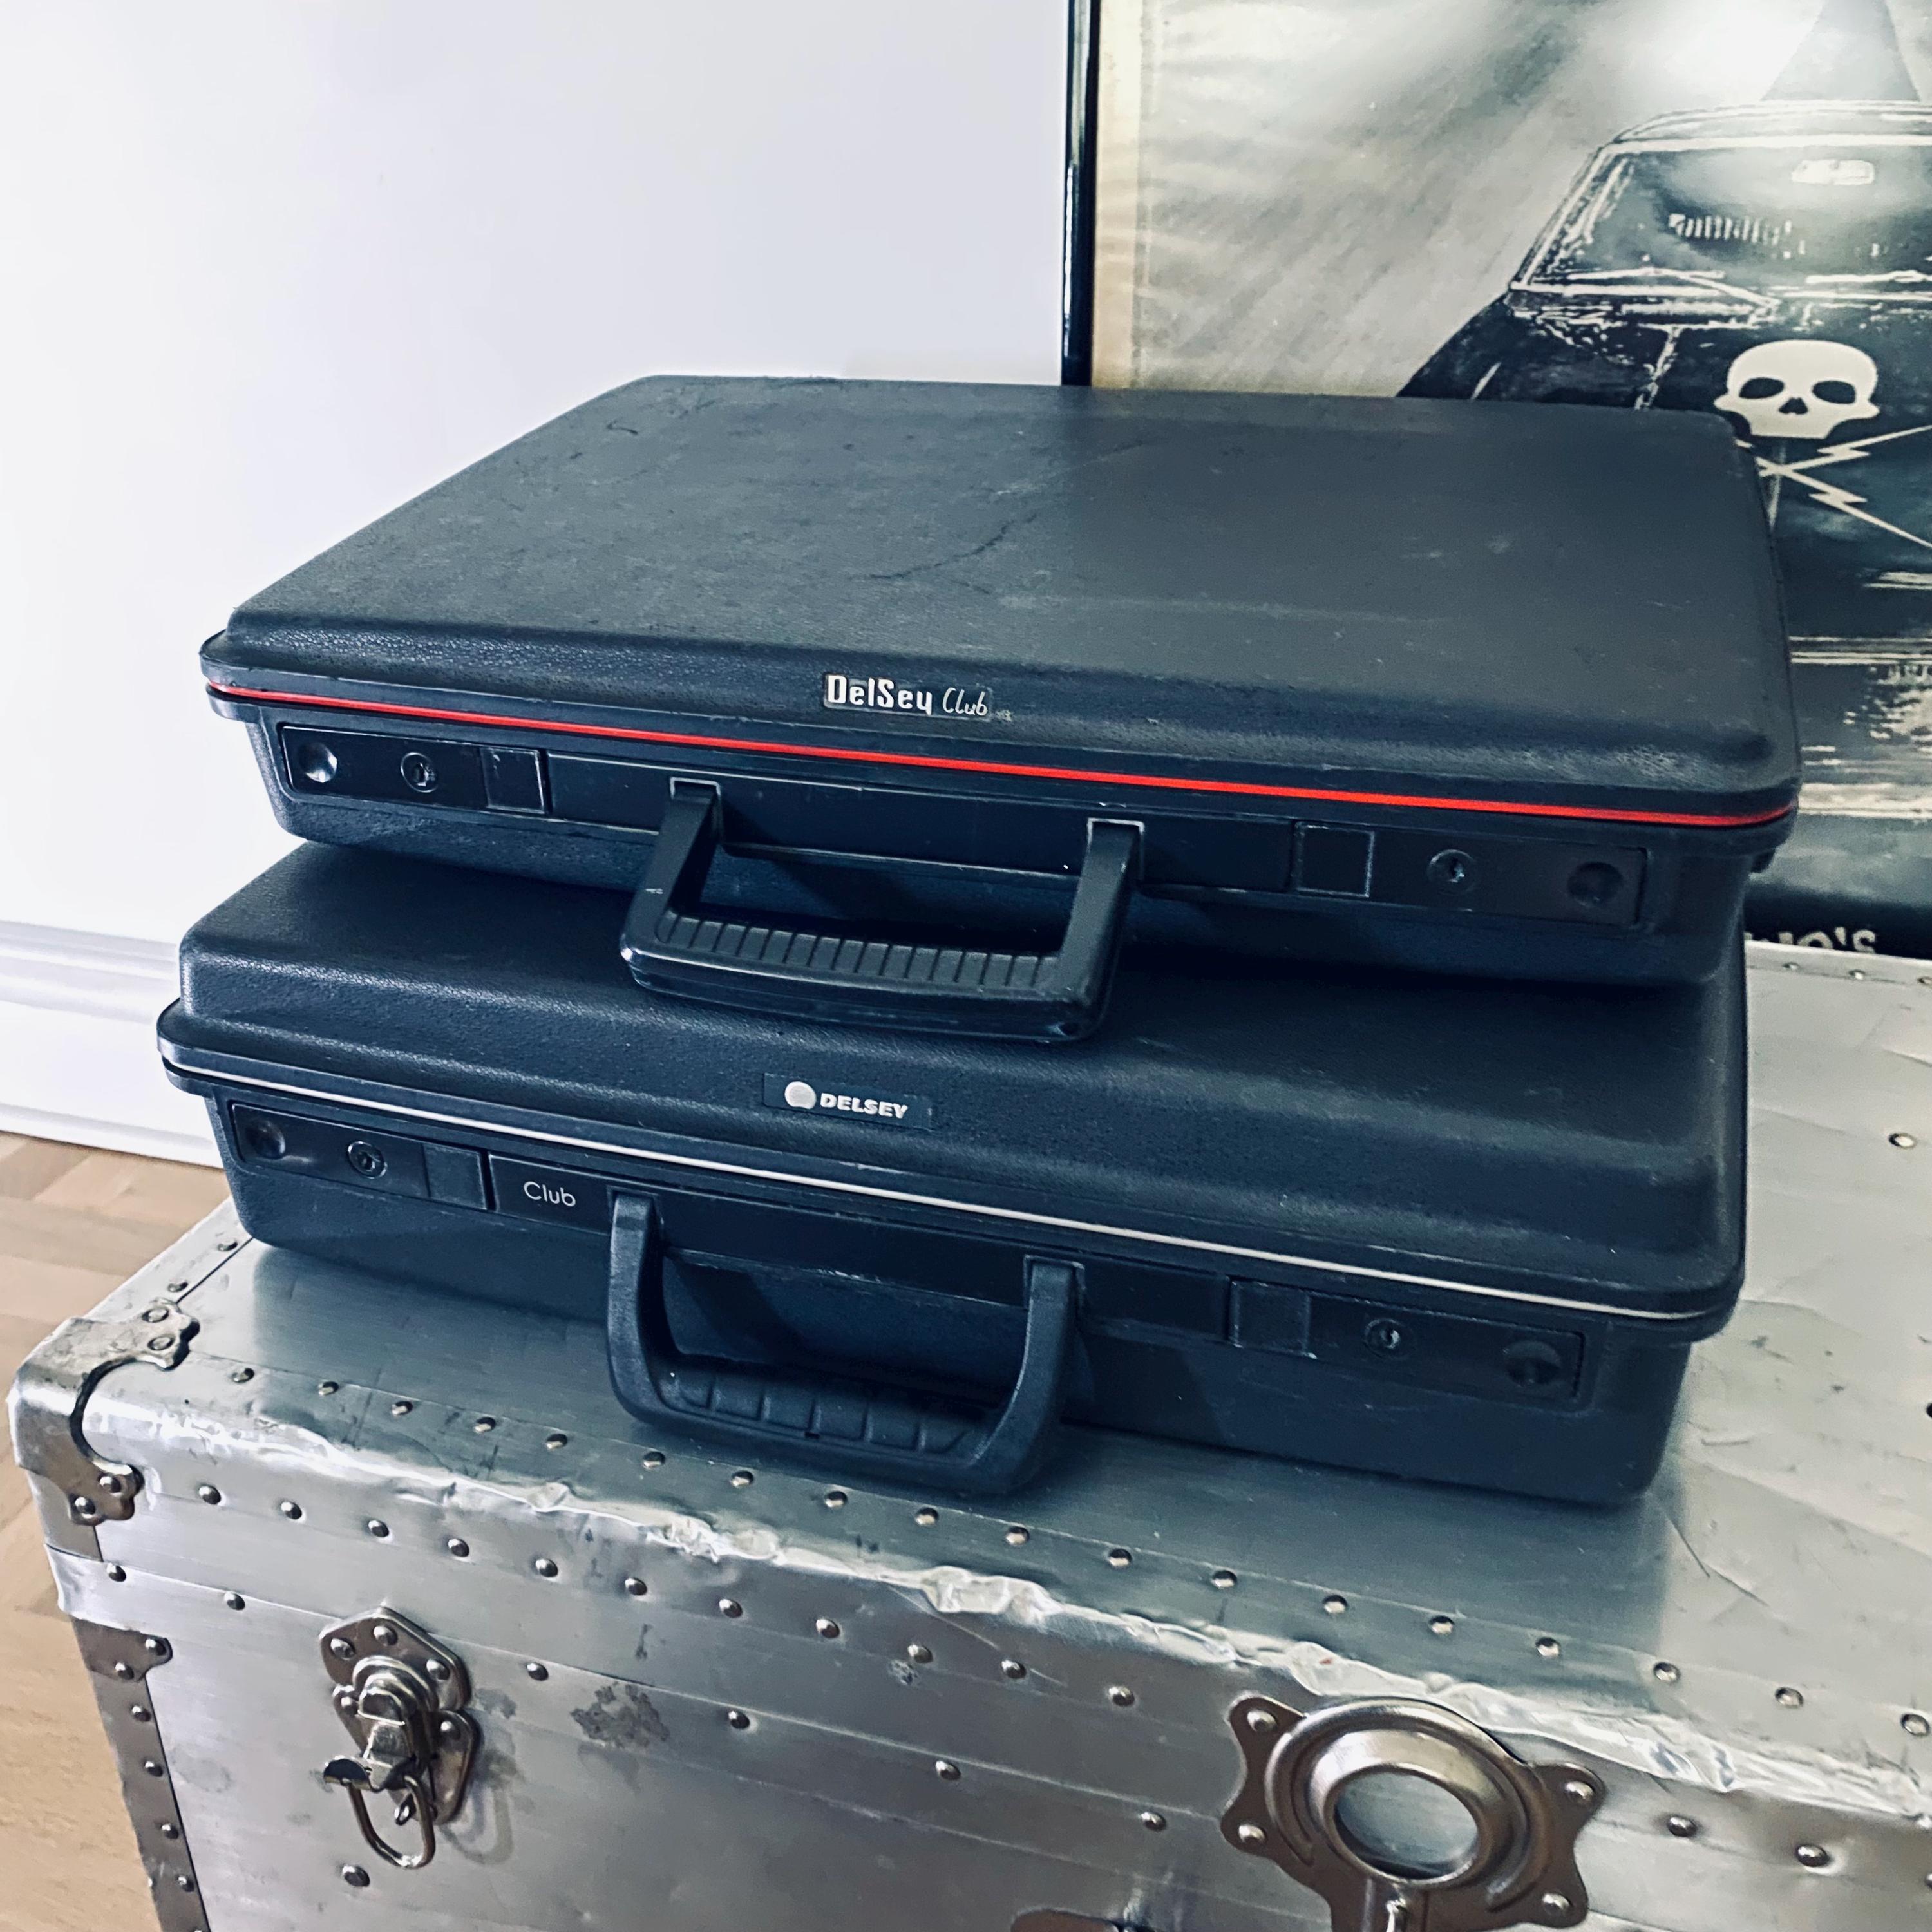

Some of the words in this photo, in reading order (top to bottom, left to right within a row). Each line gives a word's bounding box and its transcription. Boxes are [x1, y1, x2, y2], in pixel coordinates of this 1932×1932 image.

[827, 675, 933, 716] DelSey
[942, 687, 989, 716] Club
[820, 1093, 908, 1119] DELSEY
[523, 1181, 576, 1207] Club
